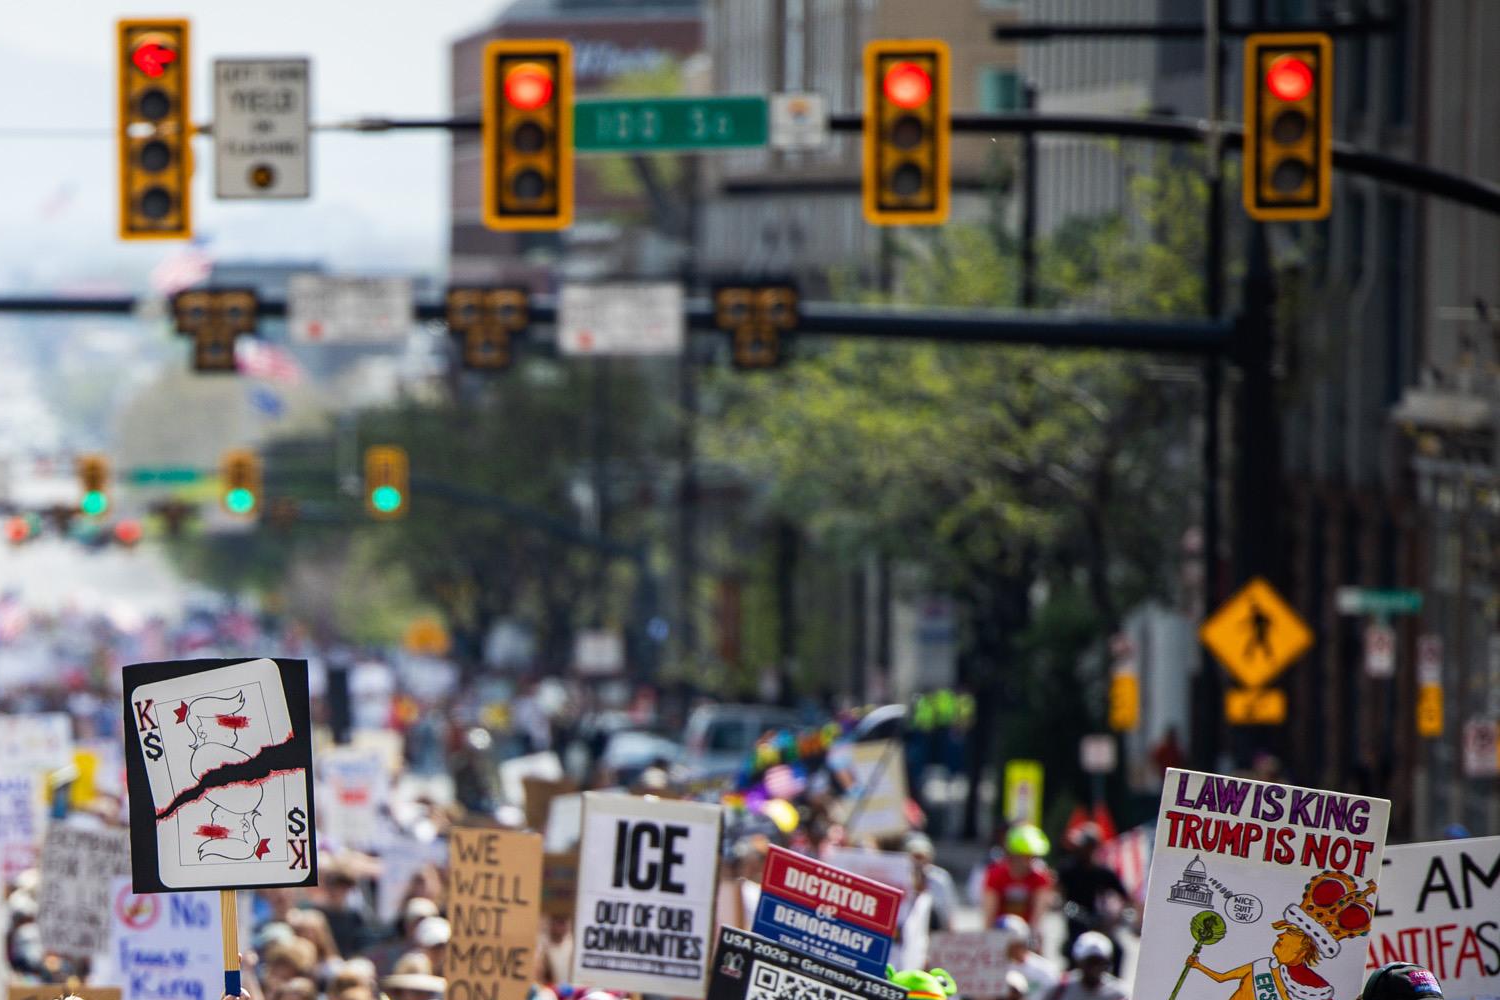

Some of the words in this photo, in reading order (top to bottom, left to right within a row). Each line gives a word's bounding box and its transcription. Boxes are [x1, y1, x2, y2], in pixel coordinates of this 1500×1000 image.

[135, 699, 158, 732] K
[1175, 772, 1252, 816] LAW
[1251, 785, 1287, 822] IS
[1289, 789, 1371, 835] KING
[455, 834, 500, 866] WE
[612, 820, 690, 894] ICE
[1166, 810, 1264, 858] TRUMP
[1263, 827, 1296, 865] IS
[1301, 832, 1374, 877] NOT
[455, 870, 529, 905] WILL
[784, 866, 878, 917] DICTATOR
[1234, 897, 1255, 906] NICE
[453, 904, 506, 939] NOT
[596, 901, 629, 925] OUT
[633, 903, 654, 927] OF
[658, 906, 693, 933] OUR
[773, 904, 873, 954] DEMOCRACY
[450, 942, 529, 980] MOVE
[583, 926, 702, 960] COMMUNITIES
[722, 931, 751, 949] USA
[754, 941, 789, 962] 2026
[801, 958, 863, 991] Germany
